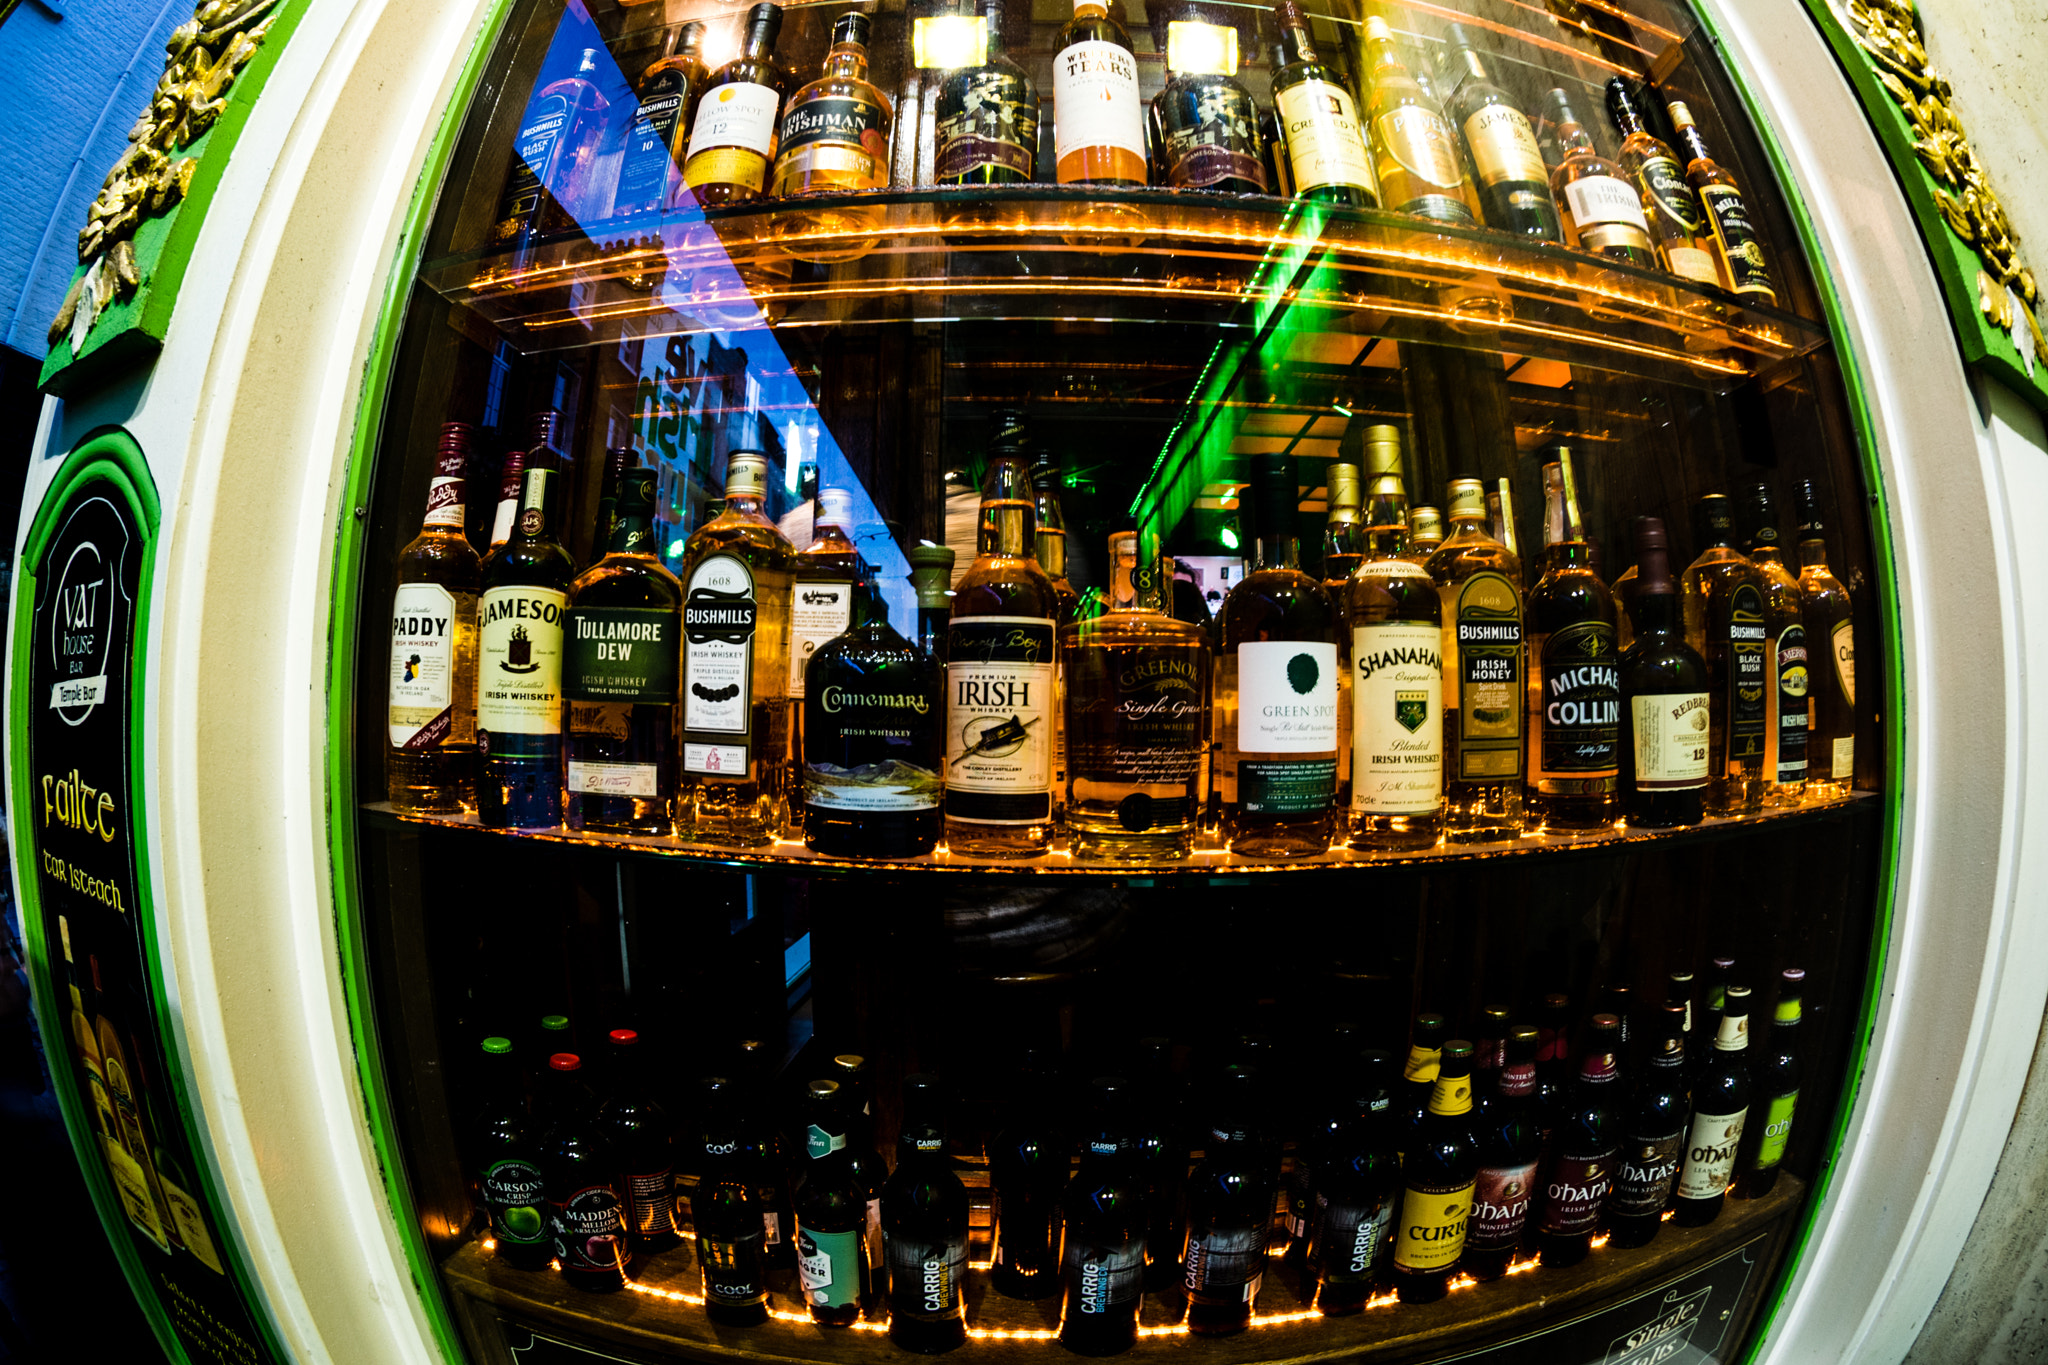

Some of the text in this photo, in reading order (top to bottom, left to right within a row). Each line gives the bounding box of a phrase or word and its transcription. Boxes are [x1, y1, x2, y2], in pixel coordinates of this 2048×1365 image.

[1067, 60, 1132, 81] TEARS
[637, 98, 678, 116] BUSHMILLS
[697, 105, 764, 123] LLOW SPOT
[522, 118, 563, 138] BUSHMILLS
[713, 122, 728, 135] 12
[782, 113, 867, 142] IRISHMAN
[1291, 119, 1349, 134] CREED
[523, 140, 549, 152] BLACK
[523, 147, 545, 158] BUSH
[642, 140, 654, 151] 10
[1418, 519, 1441, 530] BUSHMI
[708, 577, 731, 586] 1608
[1139, 570, 1151, 588] 8
[64, 579, 104, 629] VAT
[1480, 596, 1501, 605] 1608
[482, 598, 565, 630] JAMESON
[686, 609, 752, 624] BUSHMILLS
[393, 617, 448, 637] PADDY
[575, 616, 662, 641] TULLAMORE
[1460, 625, 1519, 640] BUSHMILLS
[1730, 625, 1766, 639] BUSHMILLS
[63, 631, 95, 656] house
[1005, 629, 1042, 666] Boy
[597, 642, 632, 661] DEW
[711, 651, 743, 659] WHISKEY
[1476, 660, 1508, 669] IRISH
[1739, 655, 1762, 664] BLACK
[1472, 670, 1511, 679] HONEY
[1741, 663, 1761, 672] BUSH
[582, 675, 647, 687] IRISH WHISKEY
[1394, 671, 1431, 683] Original
[1550, 666, 1619, 697] MICHAE
[514, 680, 545, 690] Distilled
[59, 685, 97, 704] Temple Bar
[485, 691, 556, 701] IRISH WHISKEY
[822, 685, 929, 715] Connemara
[957, 681, 1030, 707] IRISH
[1117, 695, 1169, 720] Single
[1263, 704, 1335, 717] GREEN SPOT
[1547, 700, 1620, 725] COLLIN
[1671, 697, 1709, 721] REDBRE
[840, 728, 911, 737] IRISH WHISKEY
[1389, 739, 1432, 752] Blended
[1372, 754, 1440, 764] IRISH WHISKEY
[1693, 748, 1706, 761] 12
[917, 1139, 942, 1147] CARRIG
[1091, 1142, 1117, 1151] CARRIG
[488, 1179, 544, 1193] CARSONS
[495, 1196, 525, 1205] ARMAGH
[506, 1192, 531, 1200] CRISP
[566, 1204, 623, 1221] MADDENS
[574, 1225, 607, 1234] ARMAGH
[582, 1217, 617, 1228] MELLOW
[1479, 1223, 1510, 1231] WINTER
[1350, 1222, 1372, 1272] CARRIG
[1363, 1230, 1377, 1268] BREWING
[800, 1260, 826, 1278] AGER
[1184, 1239, 1200, 1289] CARRIG
[715, 1283, 753, 1295] COOL
[923, 1261, 941, 1311] CARRIG
[940, 1271, 949, 1308] BREWING
[1081, 1263, 1100, 1313] CARRIG
[1096, 1275, 1108, 1313] BREWING
[1619, 1302, 1695, 1358] Single
[1632, 1338, 1679, 1365] alts
